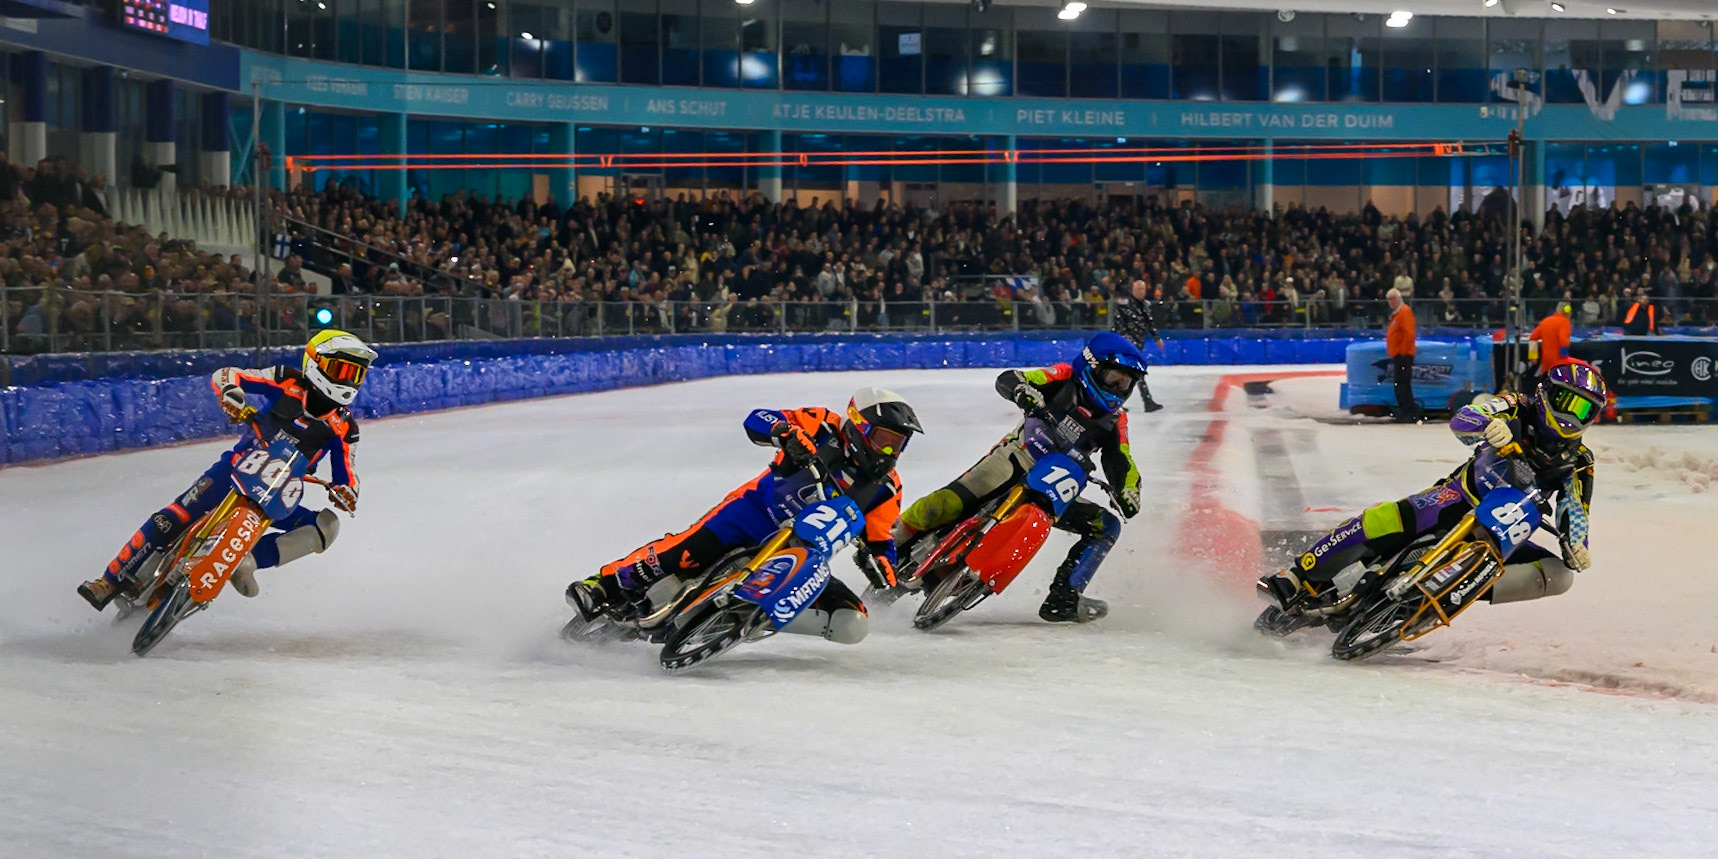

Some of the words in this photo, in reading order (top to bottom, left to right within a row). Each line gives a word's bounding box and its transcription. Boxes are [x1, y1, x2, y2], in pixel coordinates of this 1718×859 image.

[506, 91, 544, 108] CARRY
[647, 99, 675, 114] ANS
[679, 101, 726, 116] SCHUT
[772, 103, 811, 119] ATJE
[815, 105, 966, 123] KEULEN-DEELSTRA
[1016, 109, 1055, 124] PIET
[1062, 110, 1125, 126] KLEINE
[1181, 112, 1252, 127] HILBERT
[1258, 113, 1296, 128] VAN
[1302, 114, 1339, 129] DER
[1344, 114, 1394, 129] DUIM
[237, 449, 303, 509] 800
[1040, 465, 1080, 503] 16
[1490, 502, 1532, 546] 88
